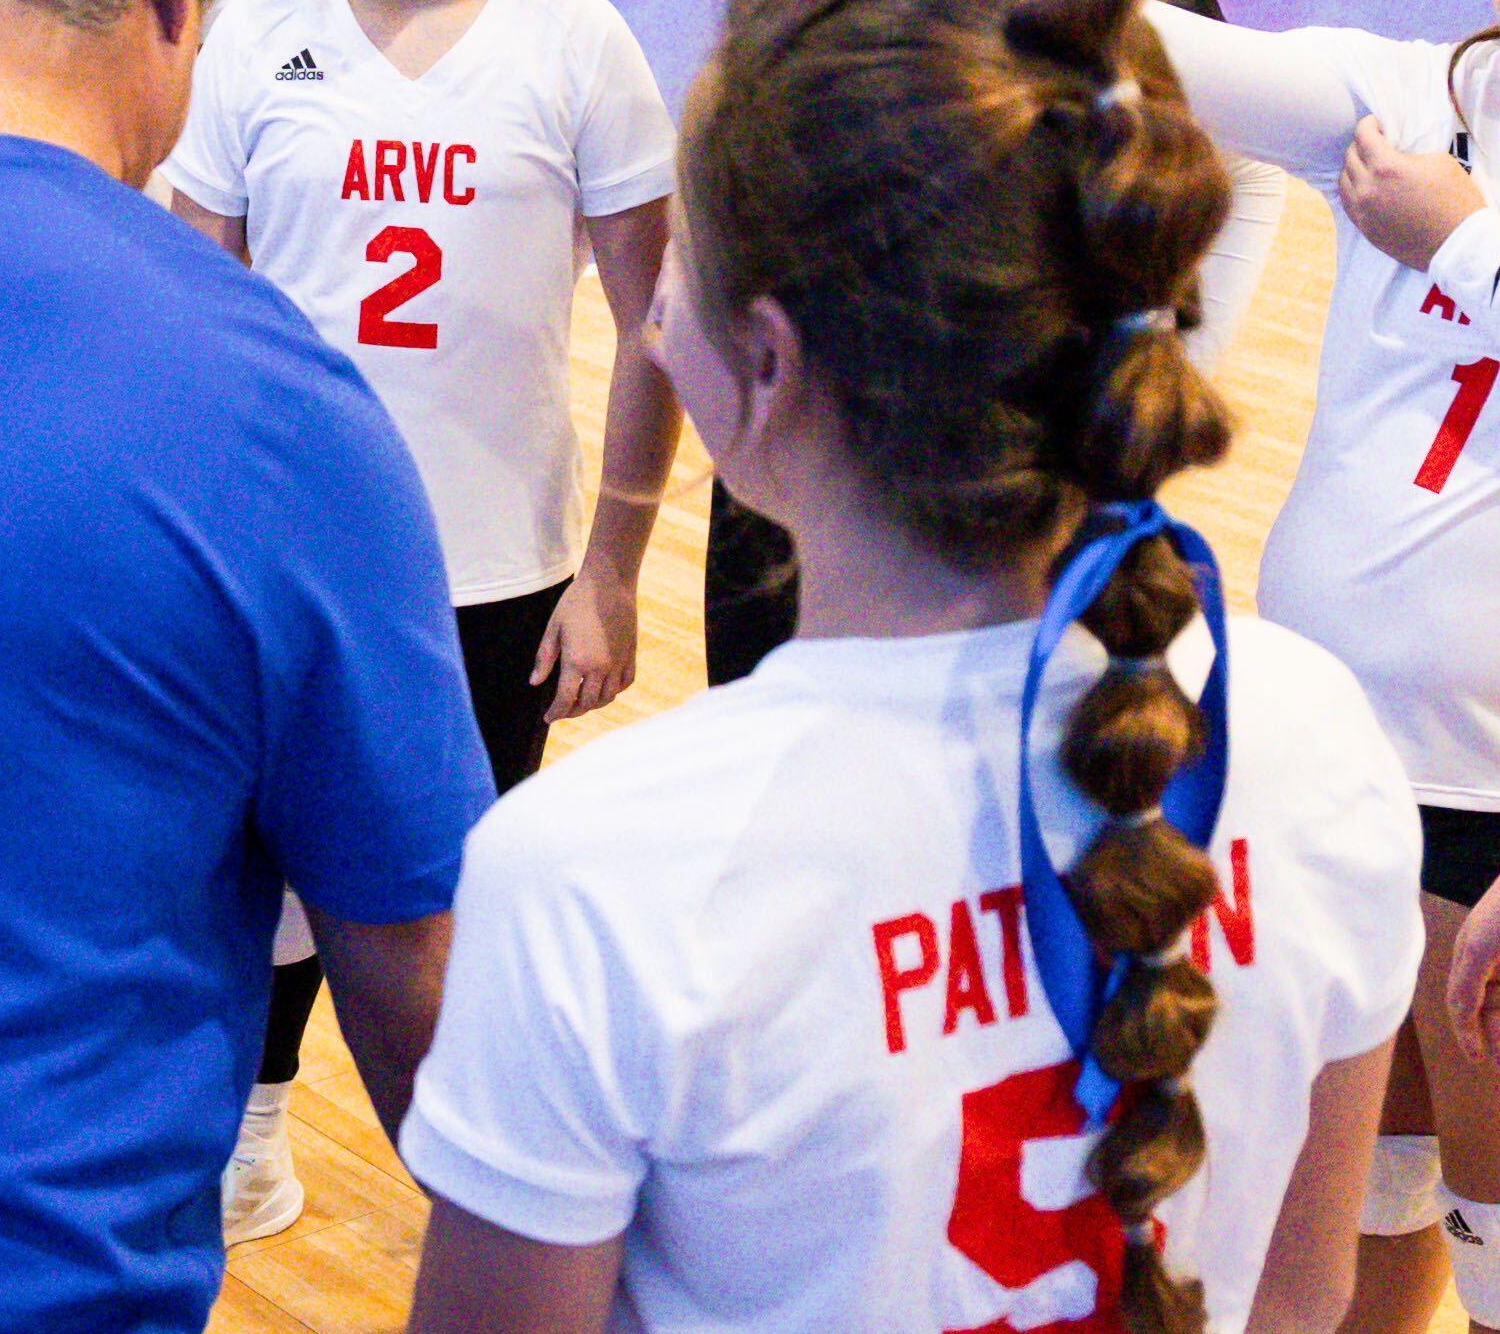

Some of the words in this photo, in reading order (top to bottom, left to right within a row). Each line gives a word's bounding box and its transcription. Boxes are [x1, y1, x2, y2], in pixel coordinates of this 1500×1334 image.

[274, 68, 325, 81] adidas
[341, 138, 477, 206] ARVC
[357, 225, 443, 350] 2
